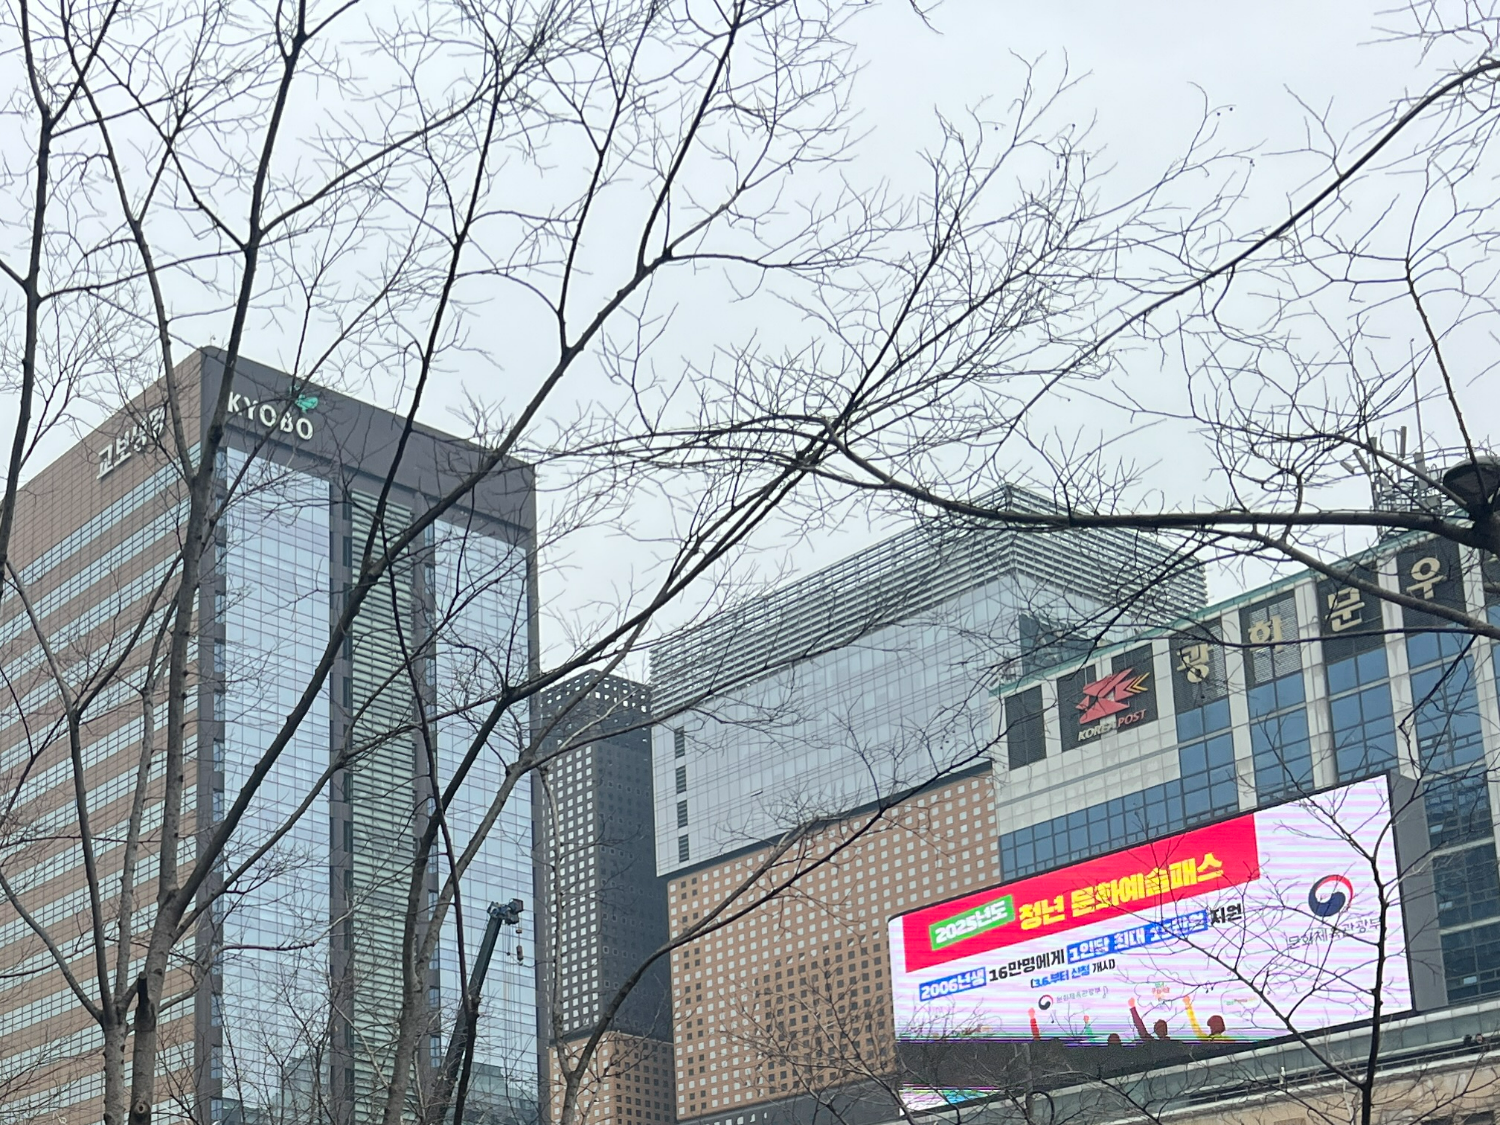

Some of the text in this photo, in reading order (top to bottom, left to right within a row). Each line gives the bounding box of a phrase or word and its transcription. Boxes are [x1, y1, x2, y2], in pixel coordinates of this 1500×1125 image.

[227, 391, 314, 441] KYOBO
[1077, 708, 1148, 742] KOREA POST
[934, 852, 1225, 944] 2025년도 청년 문화예술패스
[920, 967, 986, 1000] 2006년생
[989, 948, 1066, 983] 16만명에게
[1068, 937, 1110, 963] 1인당
[1113, 930, 1147, 951] 최대
[1210, 902, 1243, 926] 지원
[1287, 916, 1382, 950] 문화체육관광부
